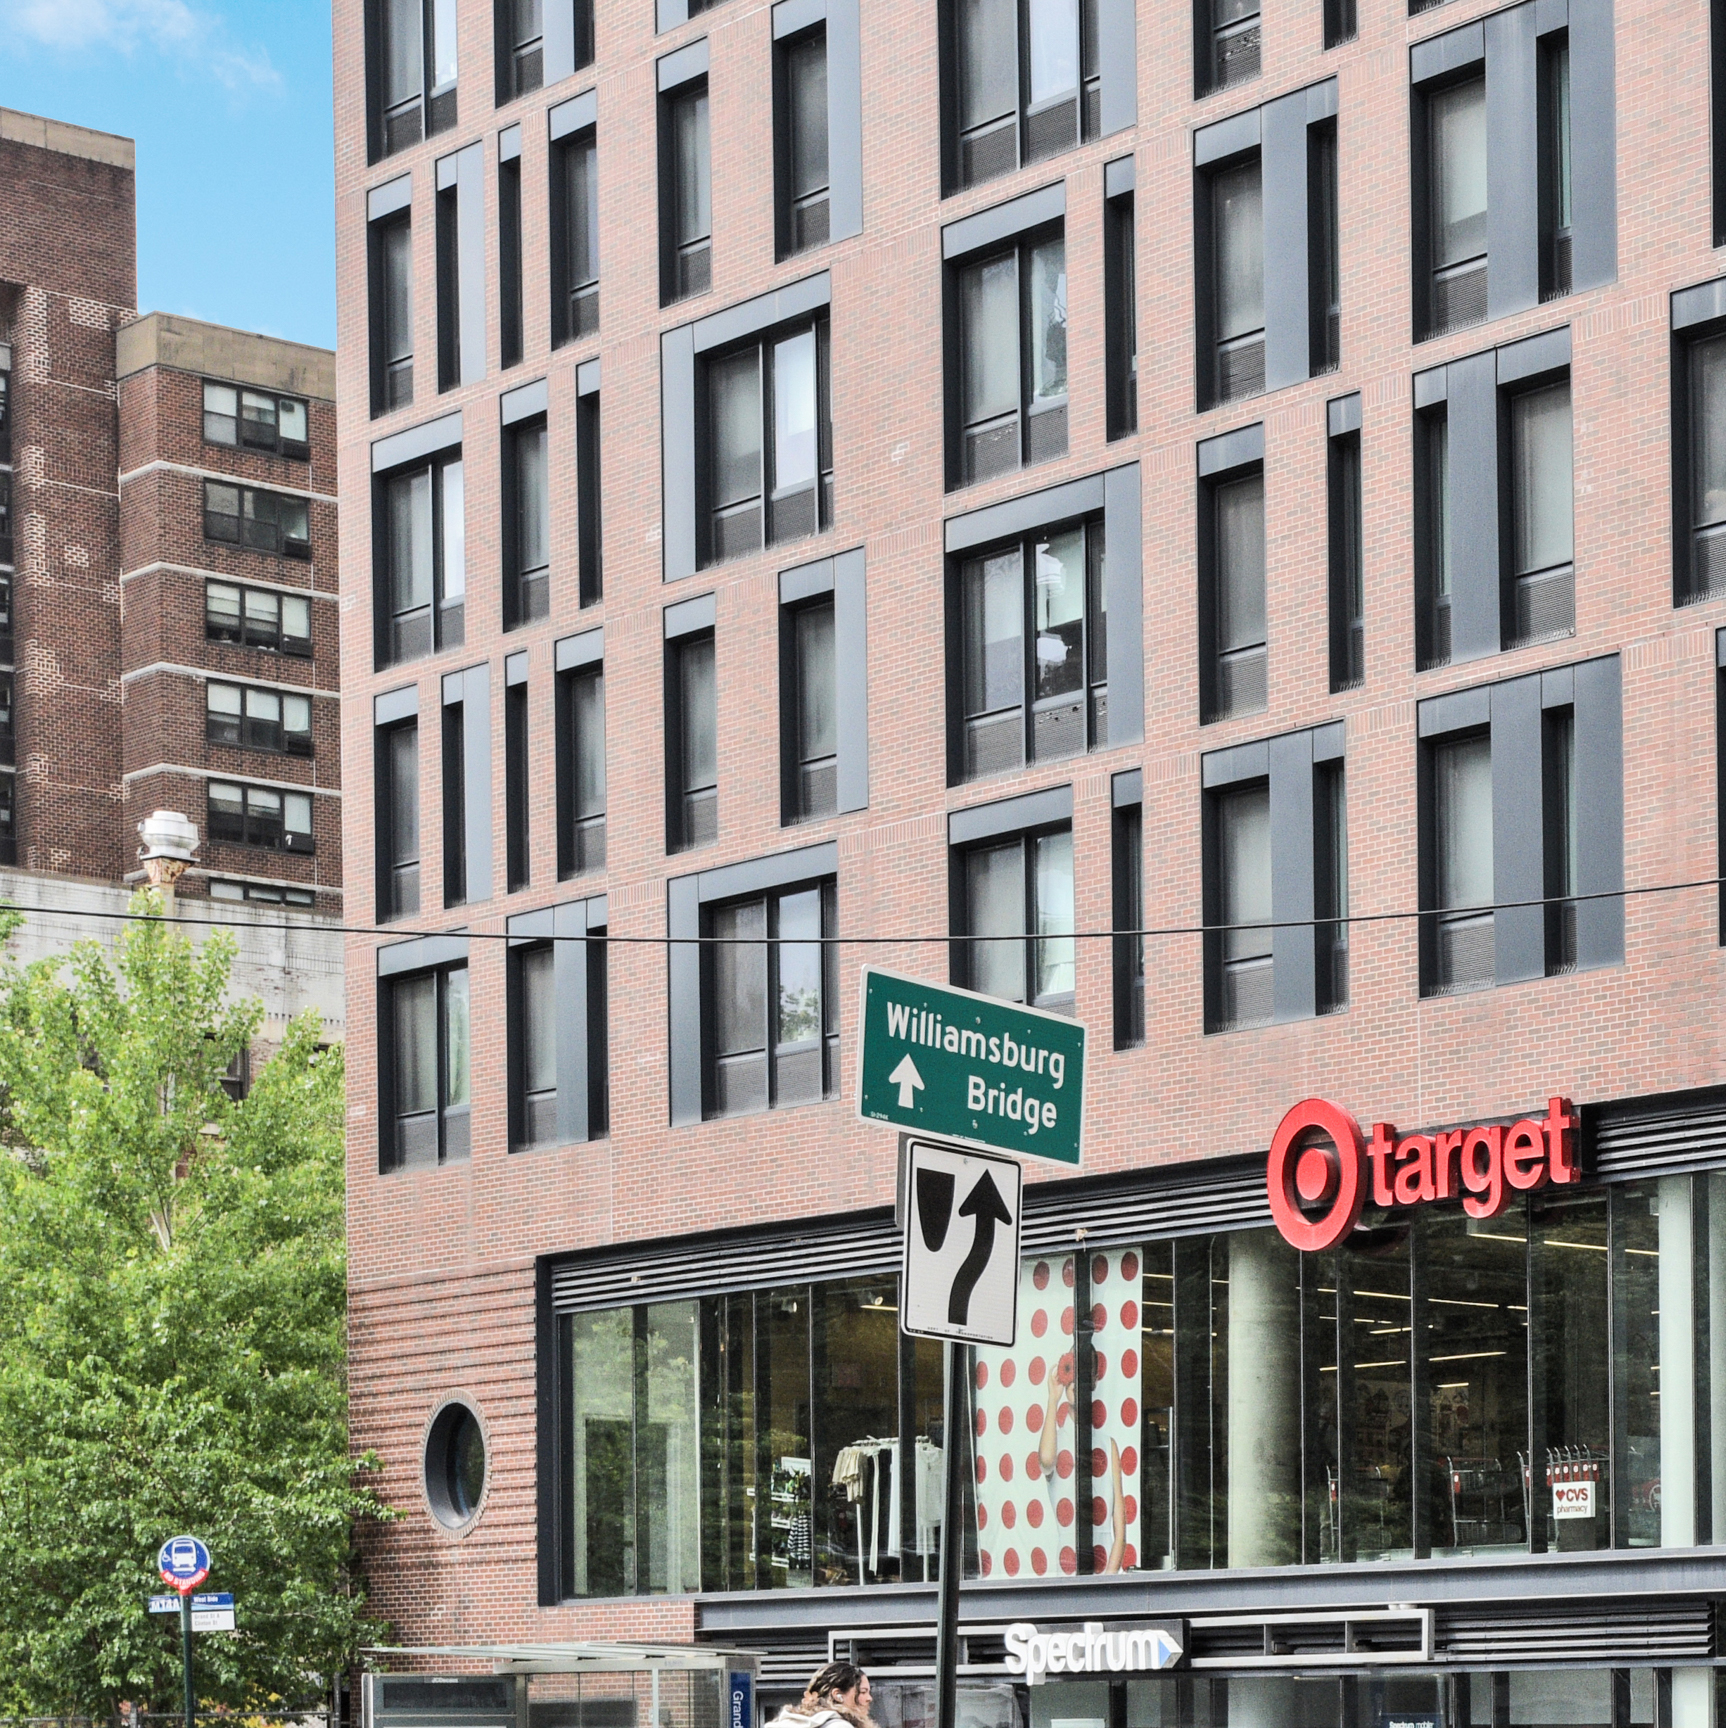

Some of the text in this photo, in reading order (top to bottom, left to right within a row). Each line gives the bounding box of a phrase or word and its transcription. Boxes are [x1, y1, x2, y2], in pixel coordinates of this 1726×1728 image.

[887, 1001, 1065, 1089] Williamsburg
[967, 1074, 1057, 1135] Bridge
[1367, 1097, 1577, 1219] target
[1556, 1504, 1588, 1515] pharmacy
[1566, 1487, 1588, 1502] CVS
[1004, 1622, 1164, 1685] Spectrum
[733, 1690, 744, 1728] Grand
